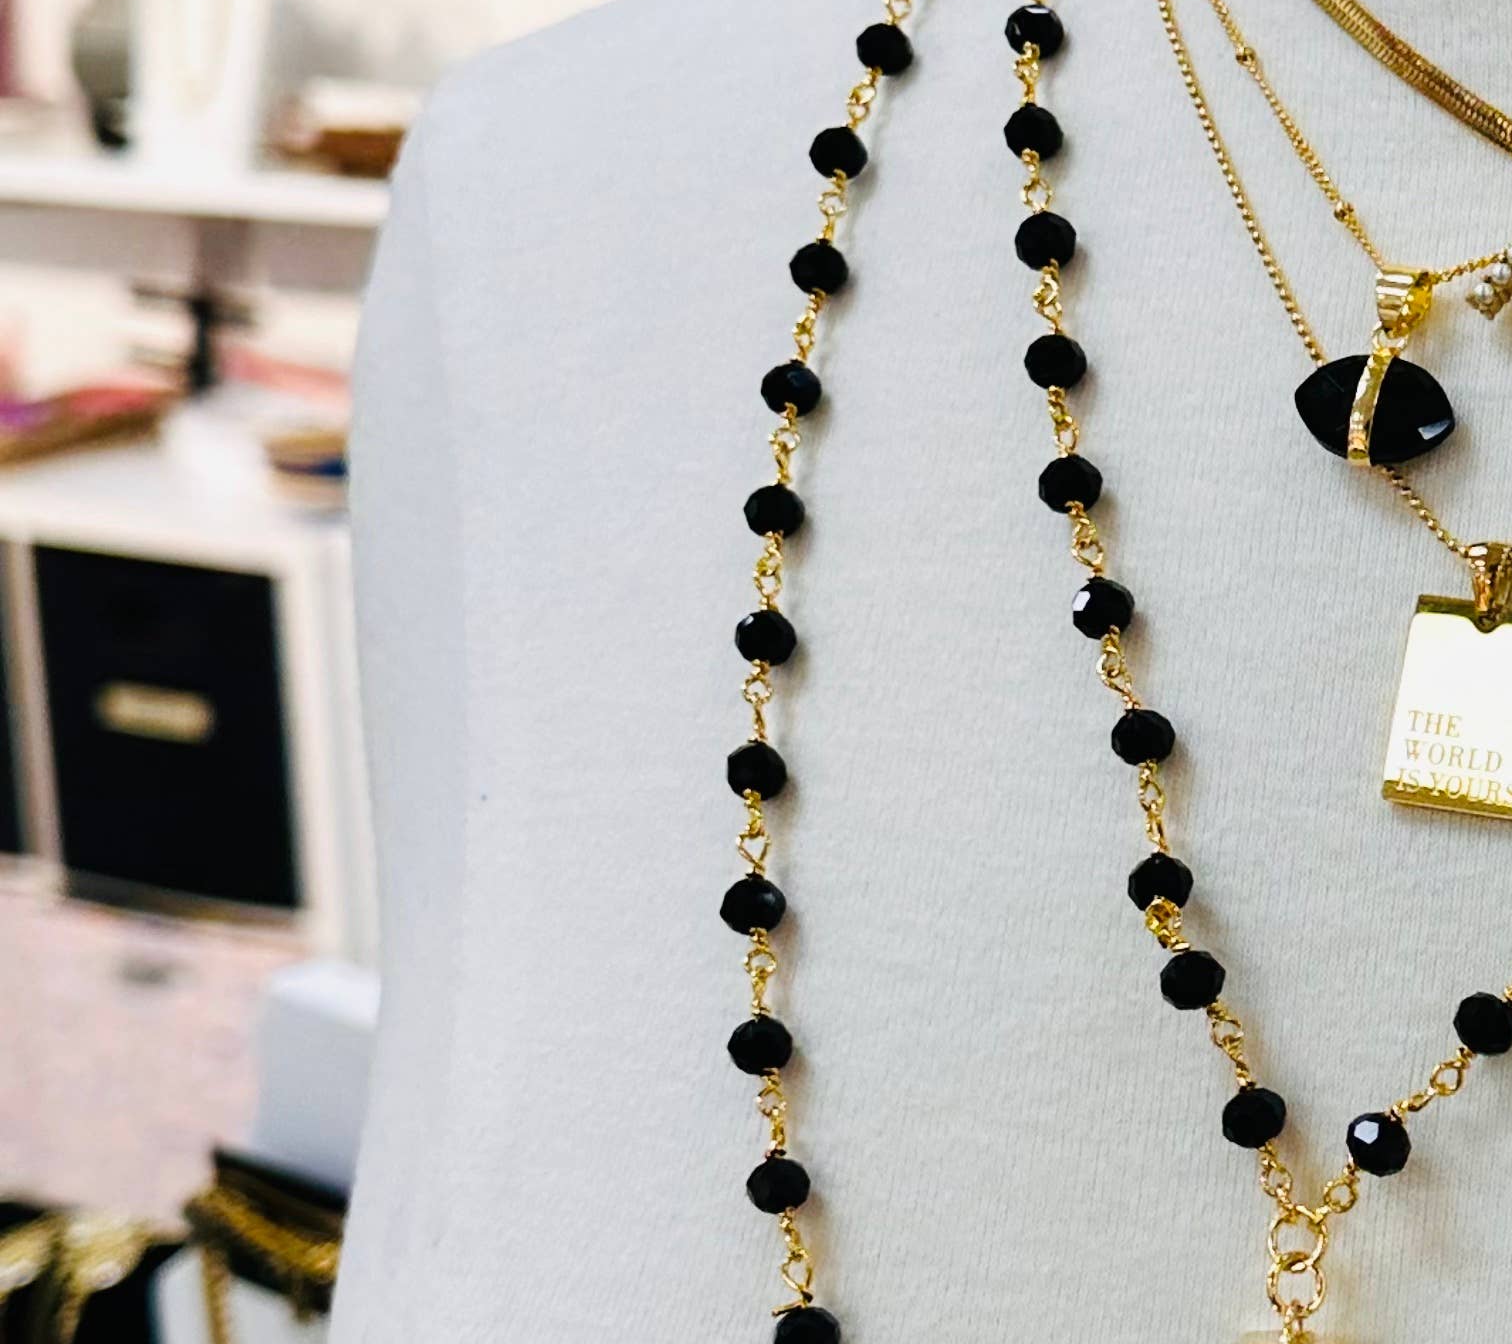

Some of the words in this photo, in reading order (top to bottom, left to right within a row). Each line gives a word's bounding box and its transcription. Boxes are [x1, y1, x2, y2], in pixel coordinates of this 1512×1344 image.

[1407, 709, 1463, 739] THE
[1404, 738, 1503, 772] WORLD
[1394, 767, 1421, 794] IS
